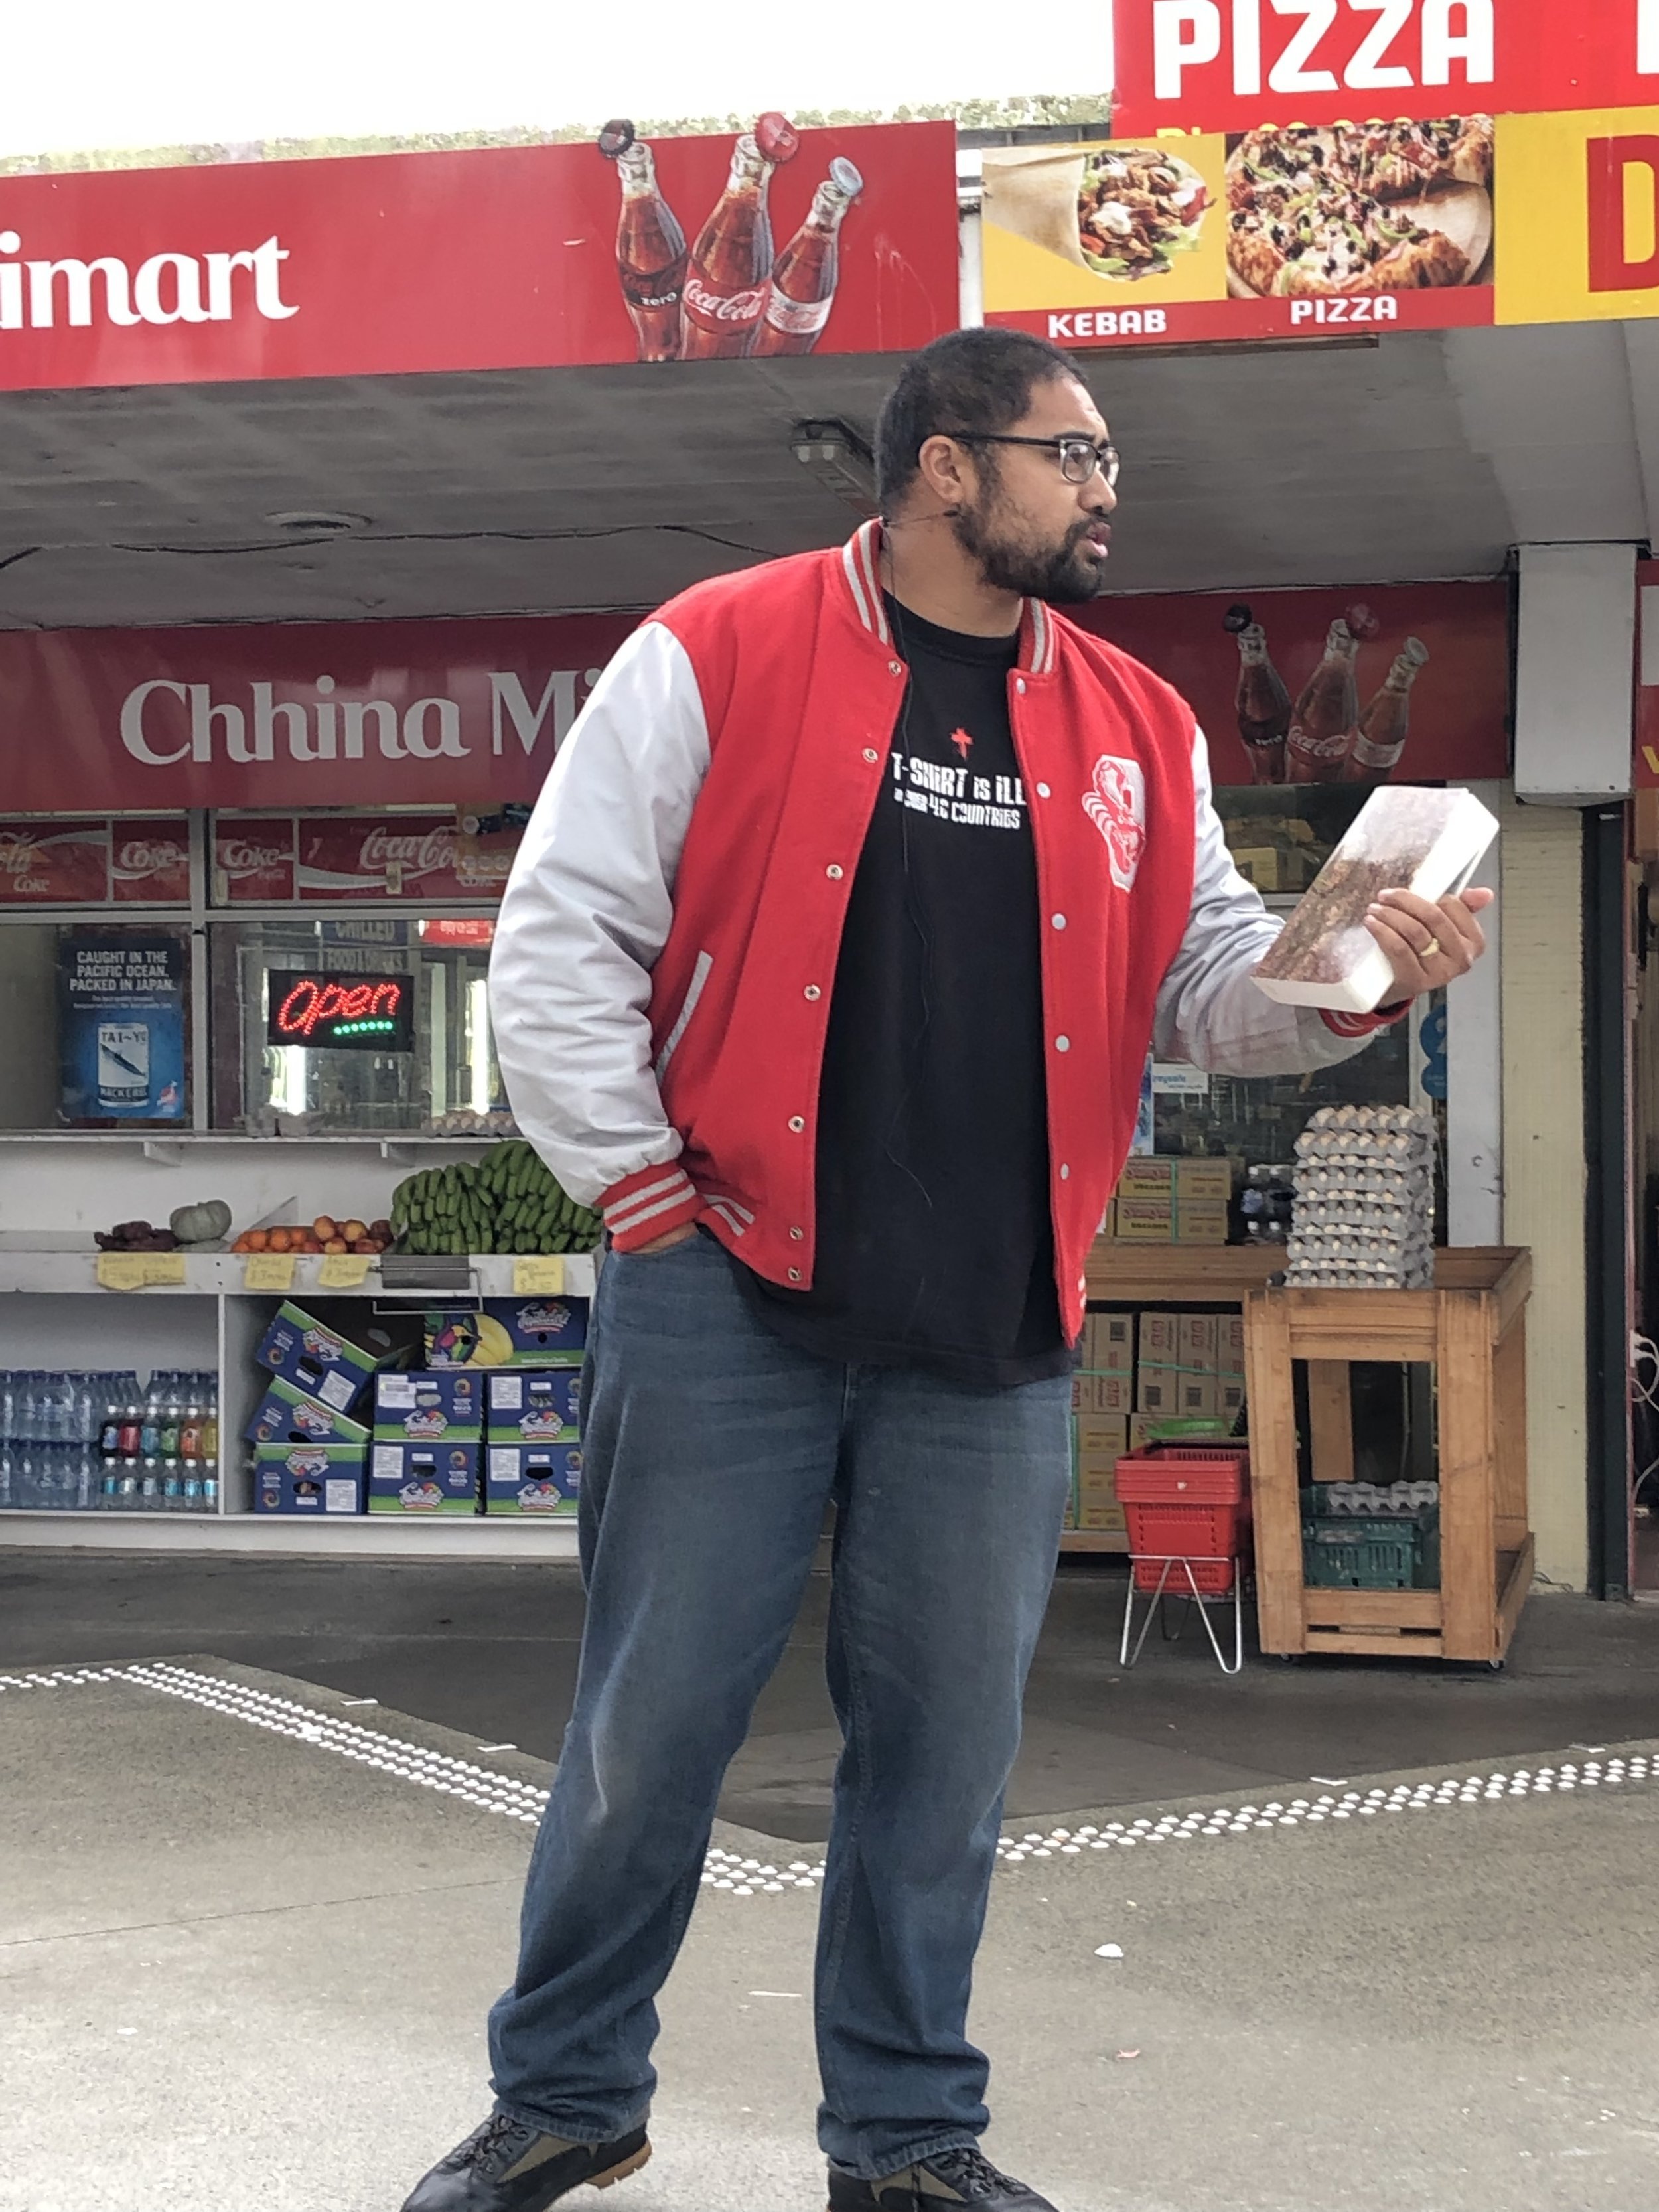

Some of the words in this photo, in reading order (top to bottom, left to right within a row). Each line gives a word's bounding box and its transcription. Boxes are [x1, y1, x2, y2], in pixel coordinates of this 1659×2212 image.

[1153, 0, 1494, 99] PIZZA
[1048, 309, 1167, 338] KEBAB
[1291, 296, 1398, 324] PIZZA
[120, 675, 471, 765] Chhina
[76, 950, 126, 964] CAUGHT
[129, 951, 142, 964] IN
[145, 950, 168, 964] THE
[76, 964, 123, 978] PACIFIC
[69, 978, 117, 991] PACKED
[119, 978, 132, 991] IN
[277, 979, 401, 1035] Open
